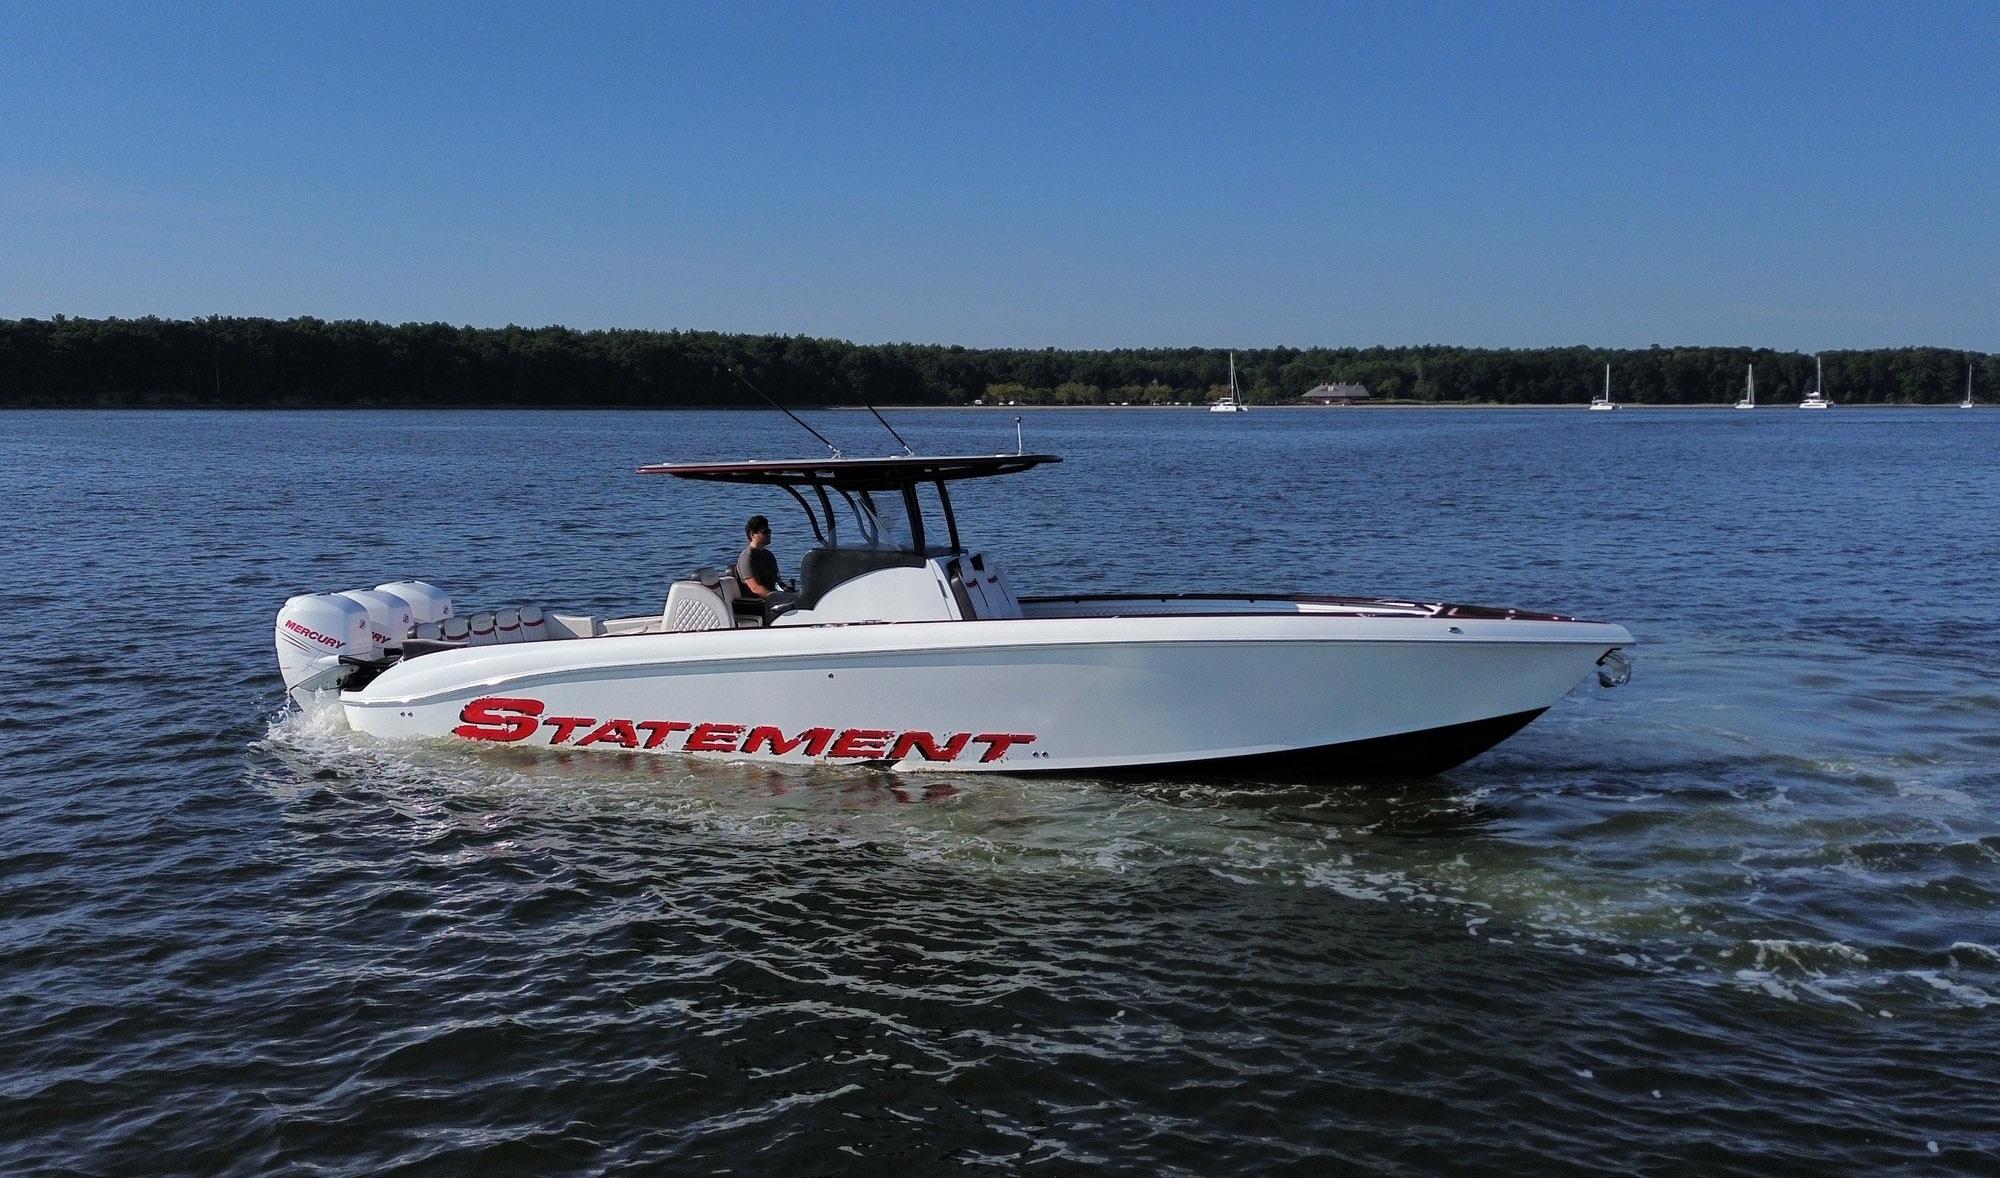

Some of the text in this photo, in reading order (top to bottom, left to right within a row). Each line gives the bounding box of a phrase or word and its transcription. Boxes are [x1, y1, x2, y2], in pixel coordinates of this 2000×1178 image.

[285, 620, 346, 649] MERCURY
[371, 631, 392, 644] RY
[451, 696, 1036, 763] STATEMENT
